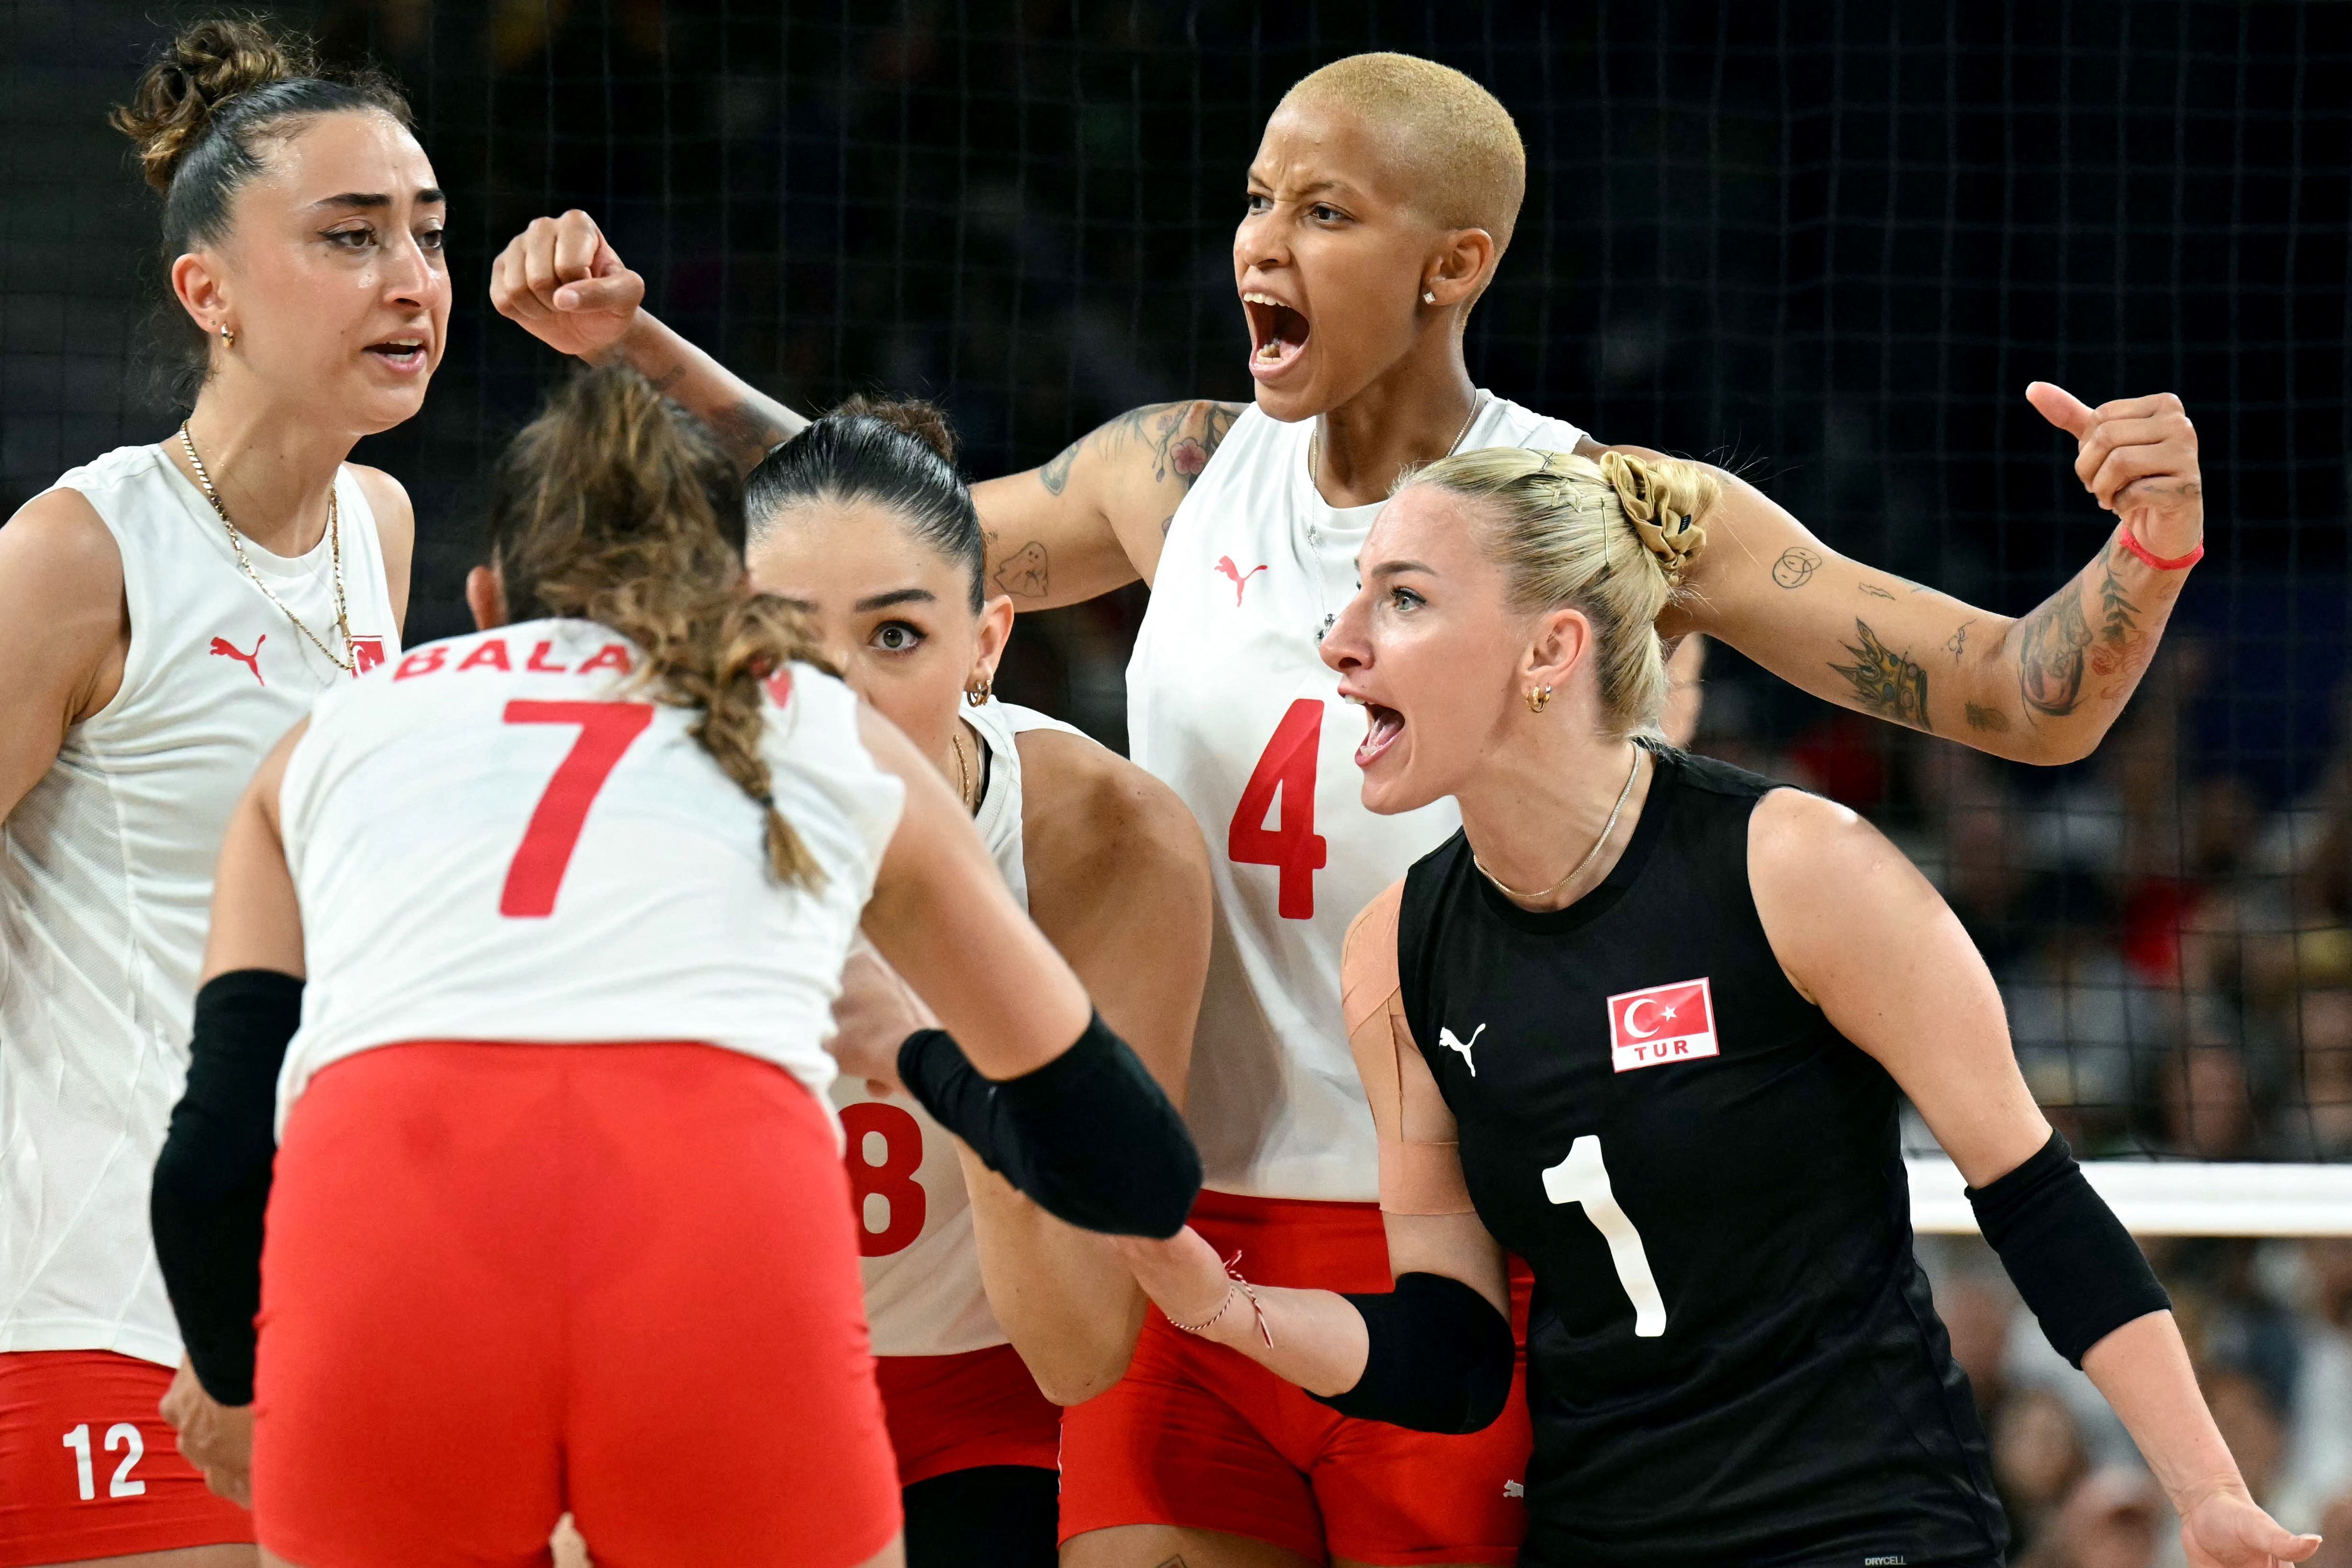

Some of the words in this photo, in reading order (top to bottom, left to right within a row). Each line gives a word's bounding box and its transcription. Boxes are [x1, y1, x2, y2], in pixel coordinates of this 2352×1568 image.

[392, 638, 633, 682] BALA
[499, 698, 655, 918] 7
[1228, 698, 1327, 919] 4
[1634, 1039, 1688, 1060] TUR
[1542, 1134, 1667, 1337] 1
[63, 1423, 146, 1501] 12
[1864, 1556, 1907, 1566] DRYCELL
